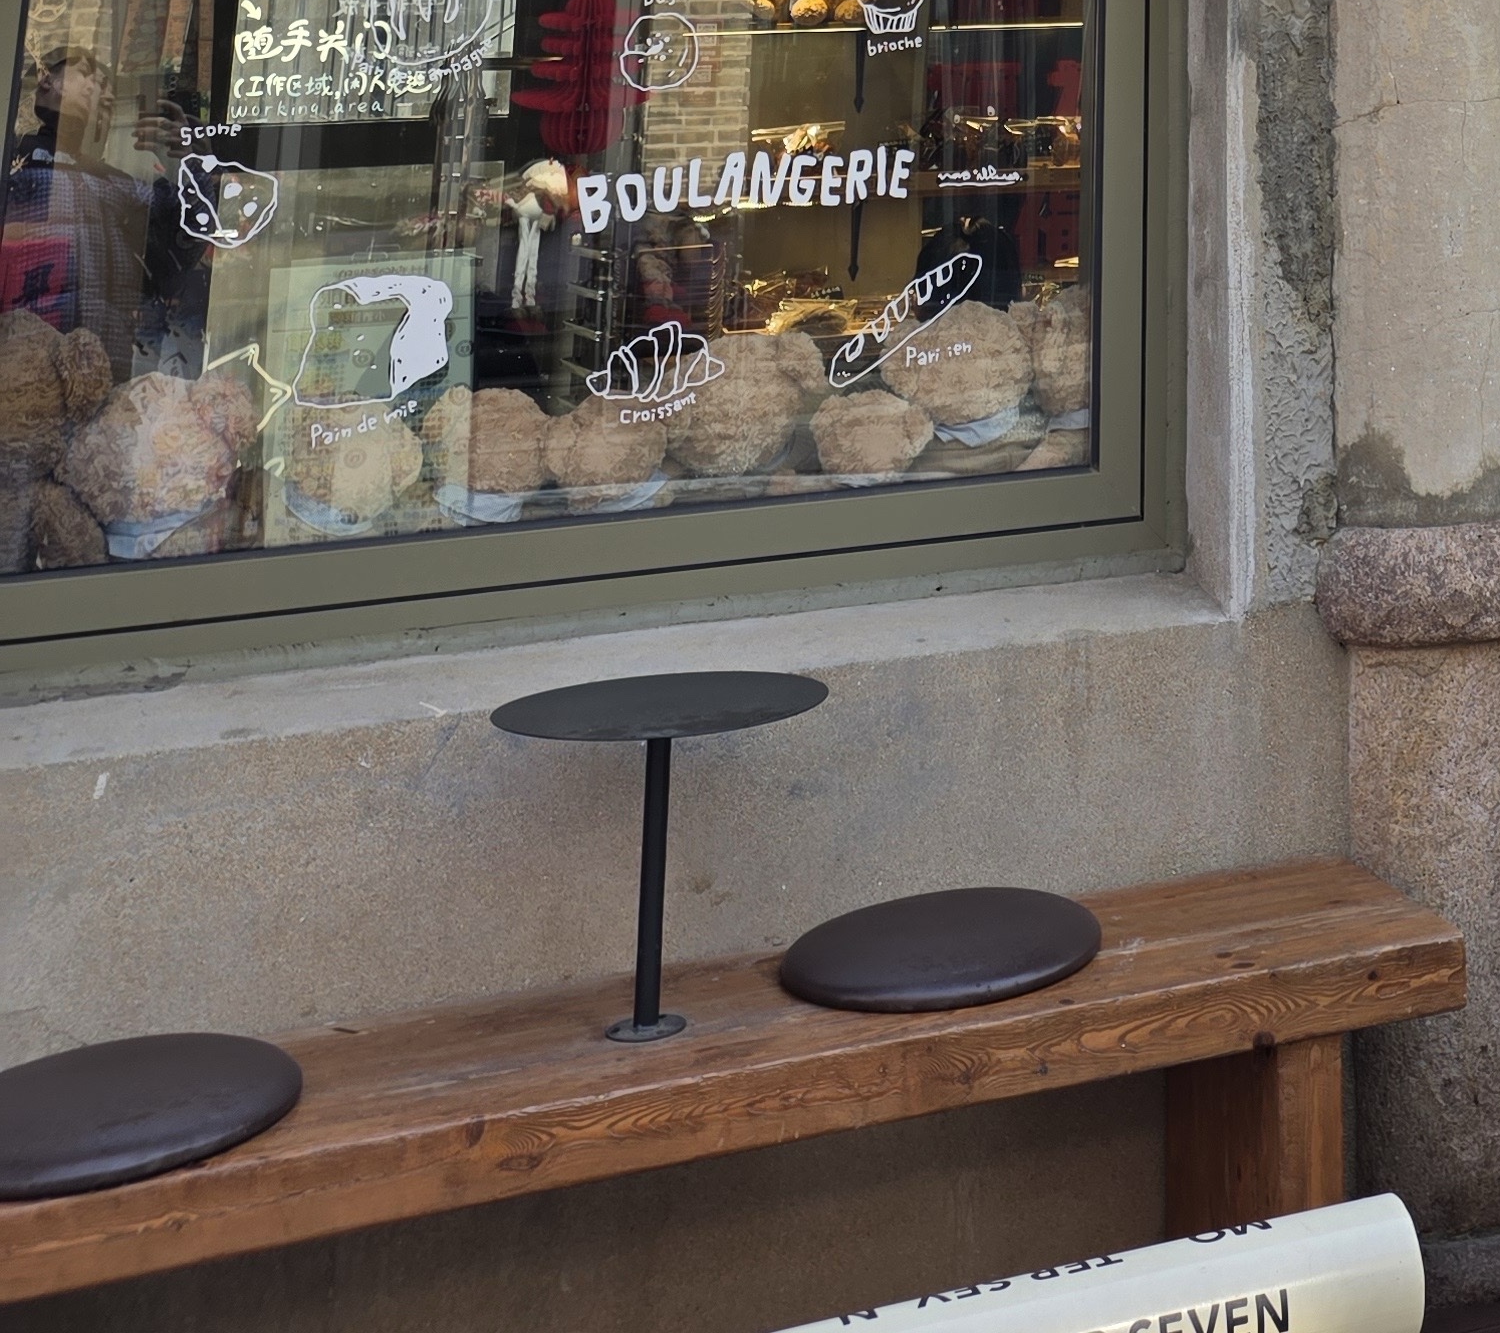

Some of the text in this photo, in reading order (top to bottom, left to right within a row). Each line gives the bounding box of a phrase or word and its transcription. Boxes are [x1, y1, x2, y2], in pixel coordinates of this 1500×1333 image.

[234, 18, 392, 64] 随手关门
[866, 34, 924, 57] brioche
[335, 99, 385, 113] area
[577, 146, 916, 234] BOULANGERIE
[357, 413, 380, 434] de
[383, 398, 419, 423] mie
